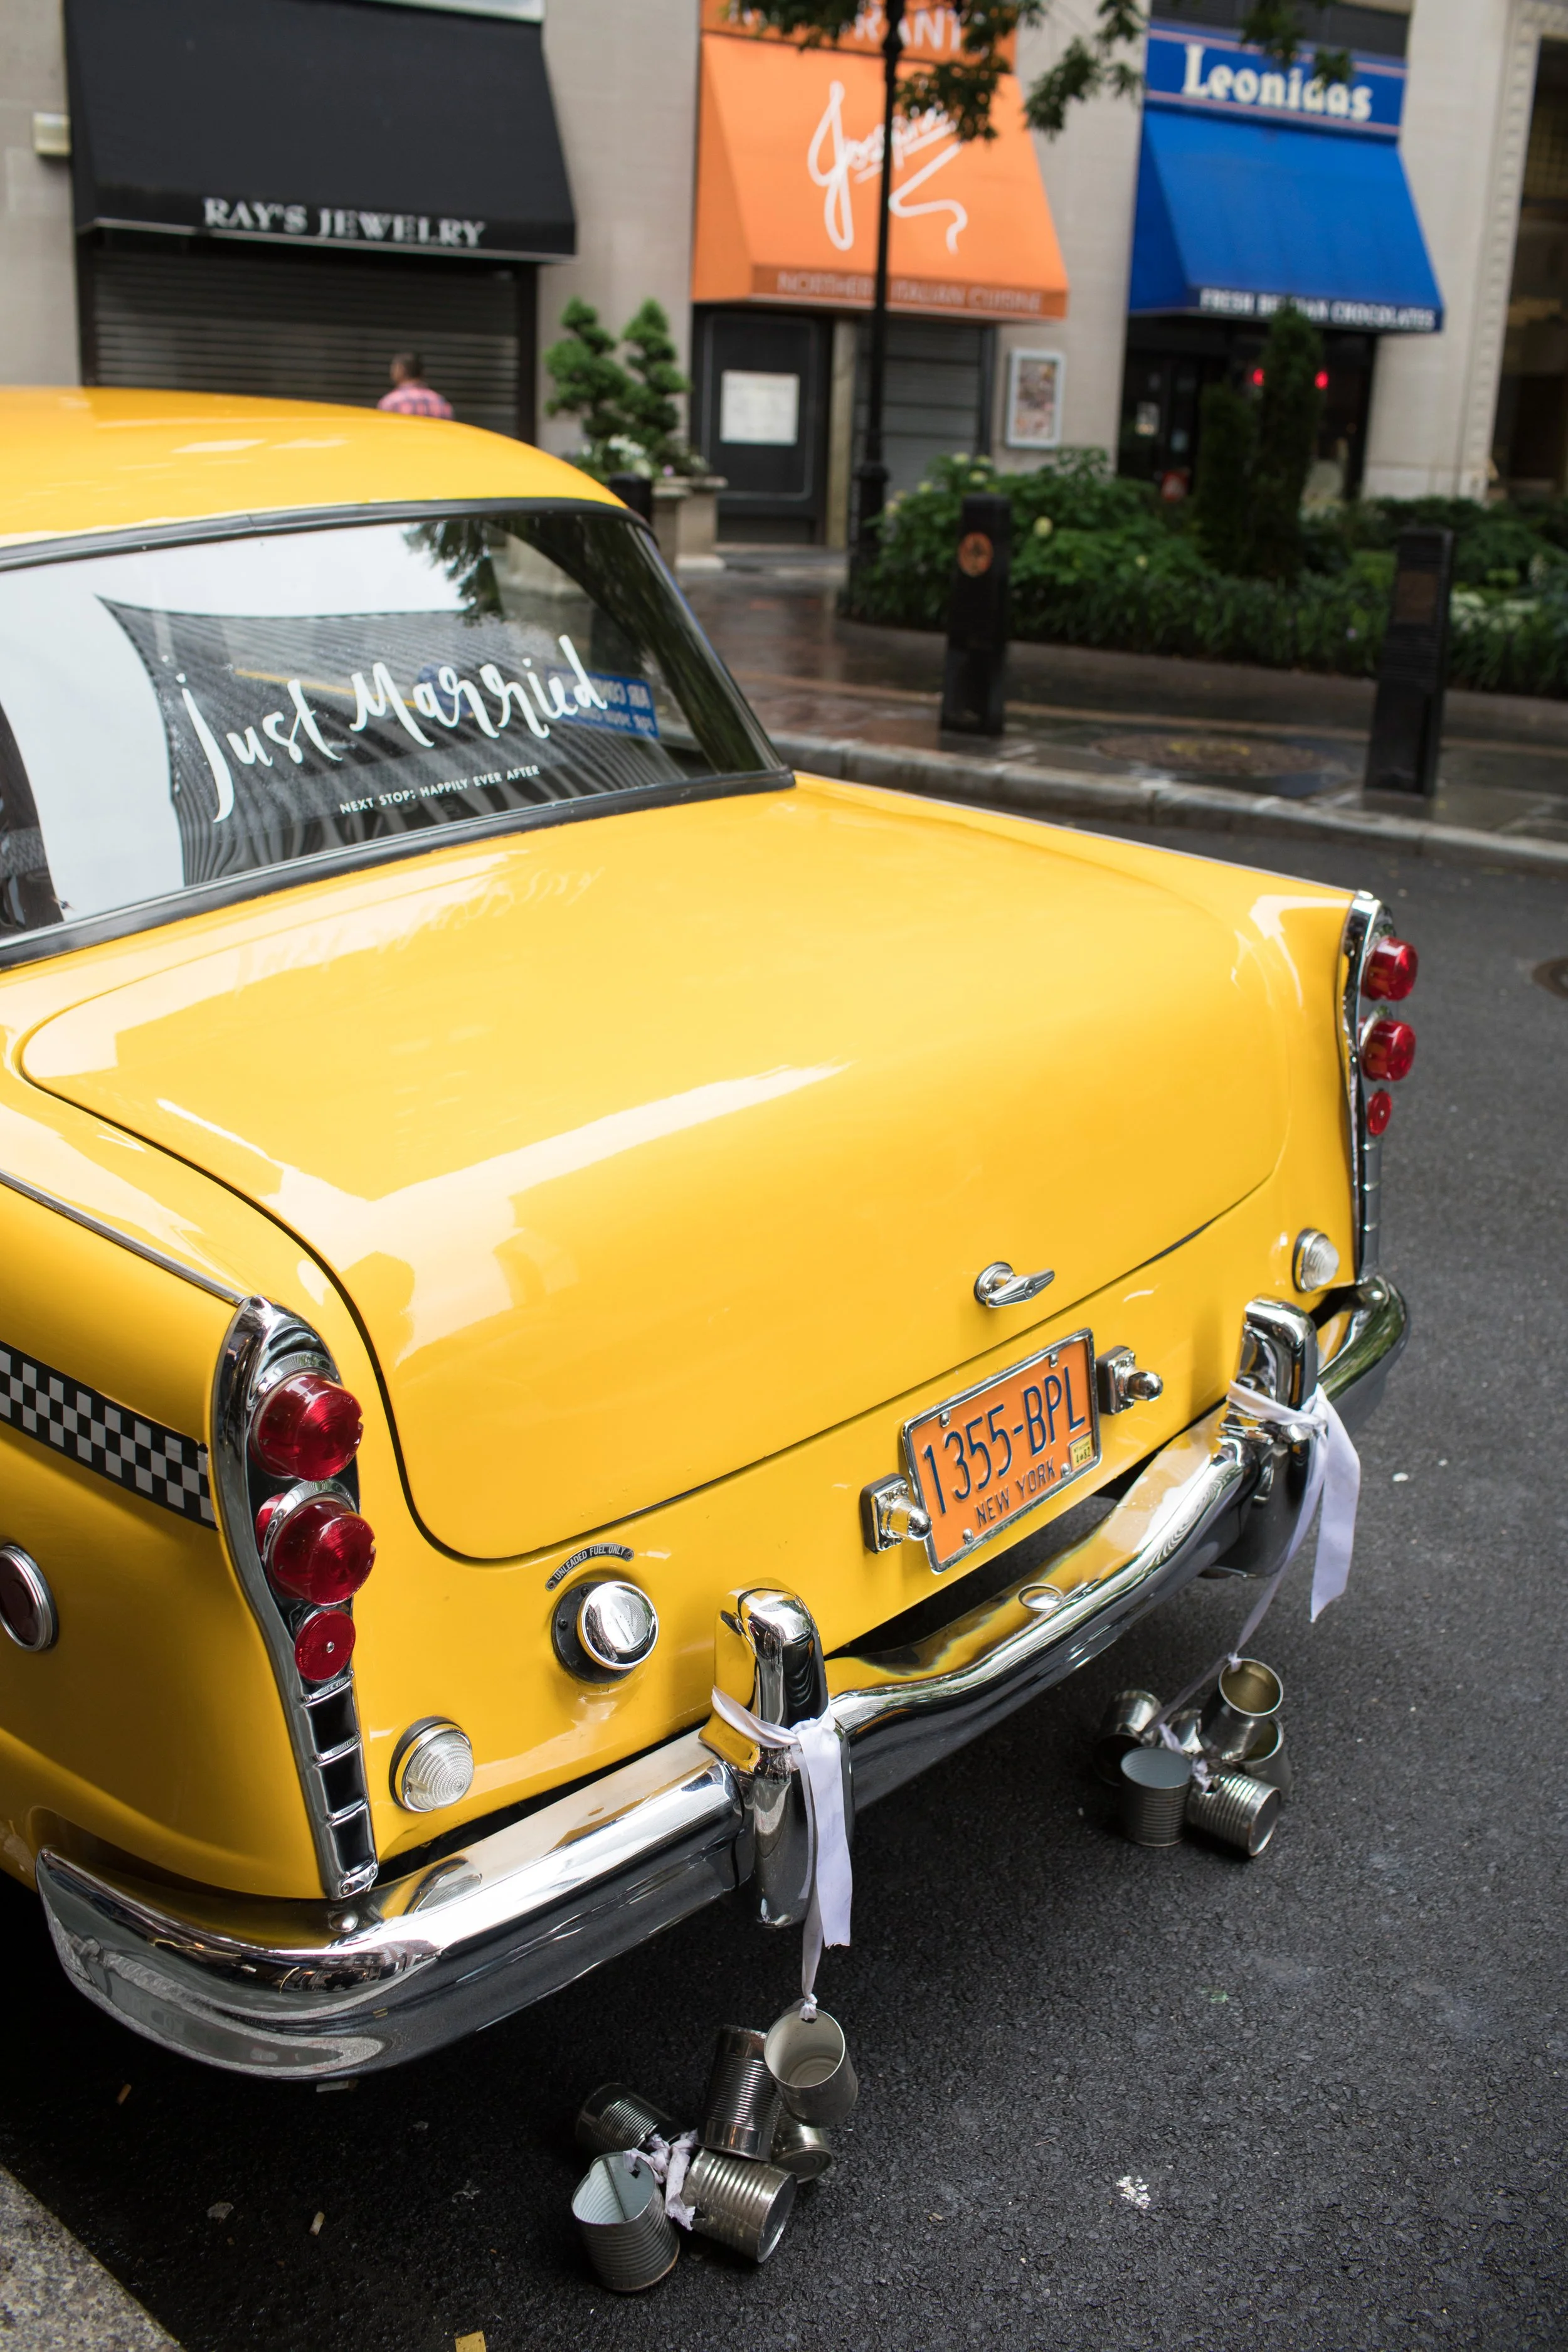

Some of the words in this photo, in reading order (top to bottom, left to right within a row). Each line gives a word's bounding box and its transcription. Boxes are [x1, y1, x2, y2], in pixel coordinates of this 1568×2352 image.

[1183, 44, 1374, 122] Leonidas
[203, 196, 307, 233] RAY'S
[319, 208, 485, 248] JEWELRY
[349, 634, 608, 748] Married
[339, 797, 374, 814] NEXT
[378, 789, 416, 806] STOP:
[420, 778, 468, 798] HAPPILY
[472, 771, 502, 787] EVER
[506, 765, 540, 781] AFTER
[923, 1366, 1086, 1515] 1355-BPL
[975, 1489, 1010, 1528] NEW
[1016, 1457, 1057, 1500] YORK
[554, 1551, 588, 1580] UNLEADED
[590, 1545, 607, 1556] FUEL
[608, 1545, 626, 1555] ONLY
